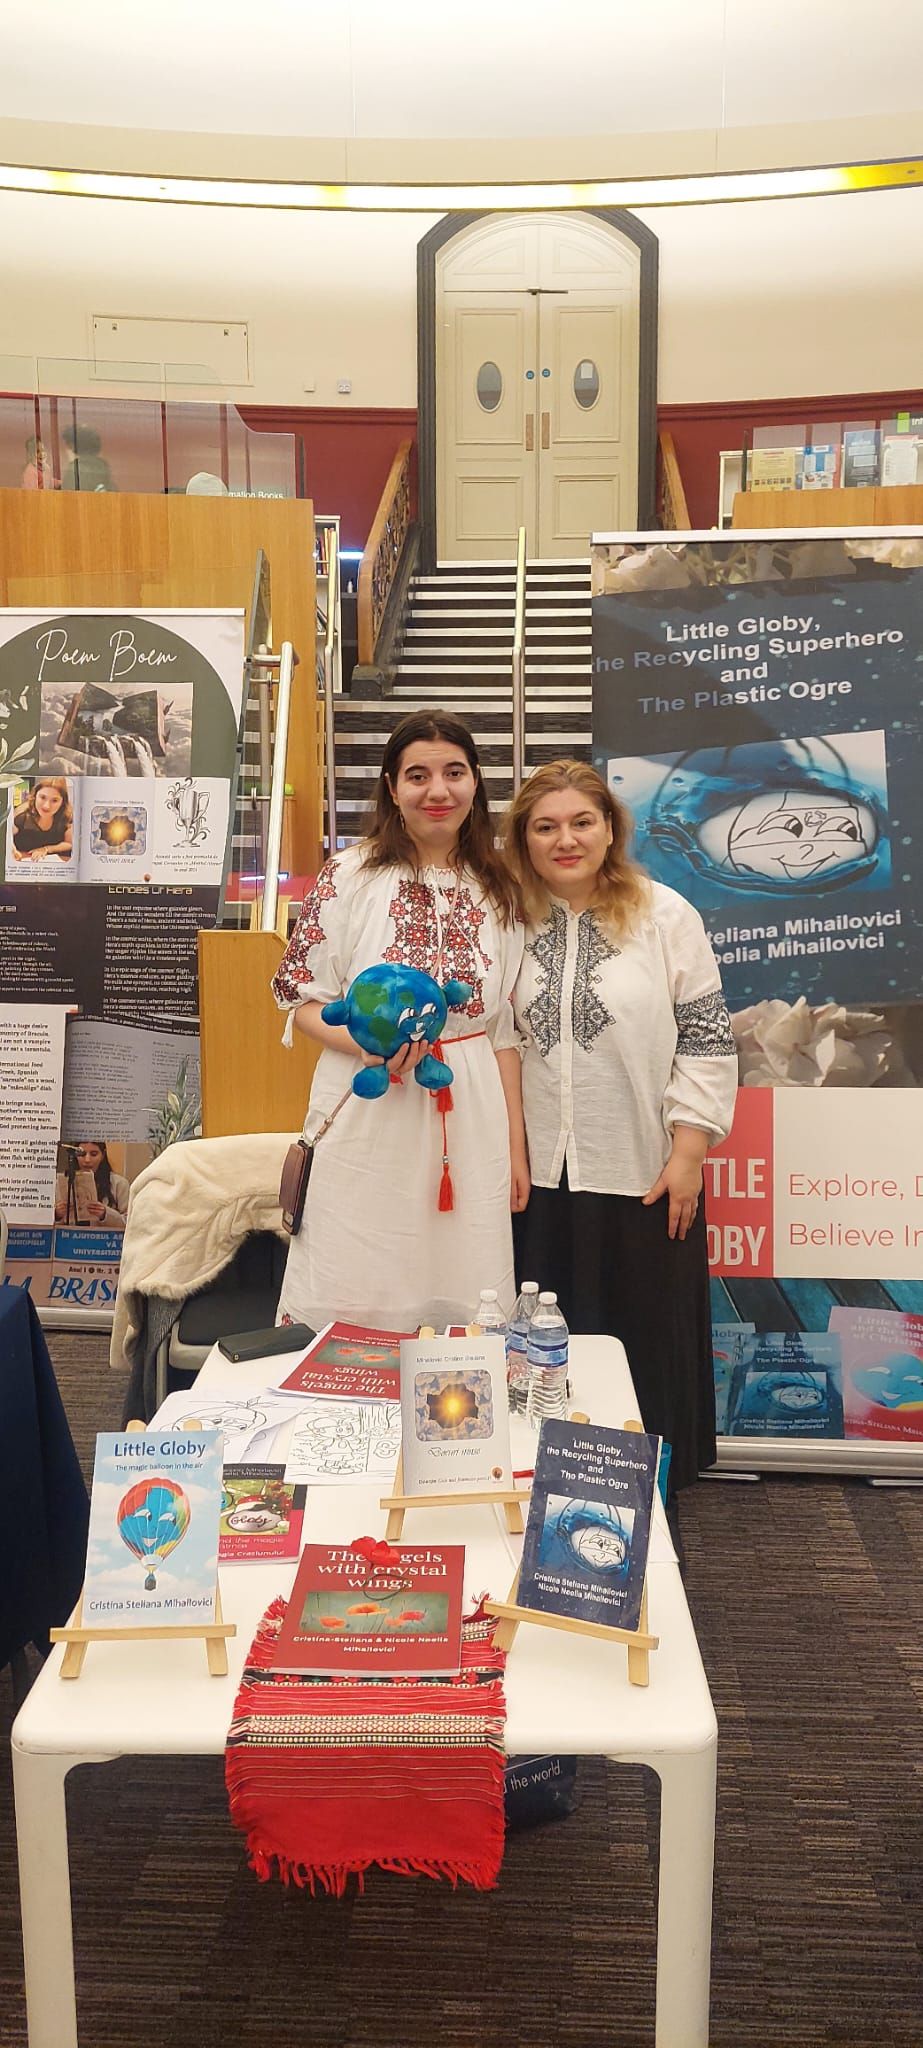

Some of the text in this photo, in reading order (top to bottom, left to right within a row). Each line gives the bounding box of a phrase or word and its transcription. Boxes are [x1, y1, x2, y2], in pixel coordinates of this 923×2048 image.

[666, 615, 821, 642] Little Globy,
[36, 629, 177, 681] Poem Boem
[634, 641, 760, 670] Recycling
[768, 628, 903, 657] Superhero
[720, 662, 768, 683] and
[638, 679, 852, 714] The Plastic Ogre
[784, 910, 901, 937] Mihailovici
[767, 933, 885, 959] Mihailovici
[703, 1158, 766, 1199] TLE
[789, 1173, 904, 1201] Explore,
[790, 1223, 894, 1247] Believe
[302, 1371, 396, 1387] with crystal
[333, 1366, 379, 1376] wings
[300, 1380, 353, 1391] angels
[114, 1440, 206, 1458] Little Globy
[573, 1439, 594, 1452] Little
[128, 1464, 147, 1473] magic
[149, 1463, 174, 1471] balloon
[182, 1462, 193, 1470] the
[547, 1446, 648, 1472] the Recycling Superhero
[587, 1464, 604, 1475] and
[560, 1470, 629, 1491] The Plastic Ogre
[327, 1550, 442, 1564] The gels
[318, 1563, 448, 1577] with crystal
[348, 1578, 413, 1591] wings
[534, 1572, 561, 1585] Cristina
[590, 1584, 628, 1599] Mihailovici
[538, 1582, 560, 1594] Nicole
[584, 1592, 621, 1607] Mihailovici
[90, 1597, 213, 1610] Cristina Steliana Mihailovici
[385, 1636, 415, 1644] Nicole
[510, 1773, 529, 1792] the
